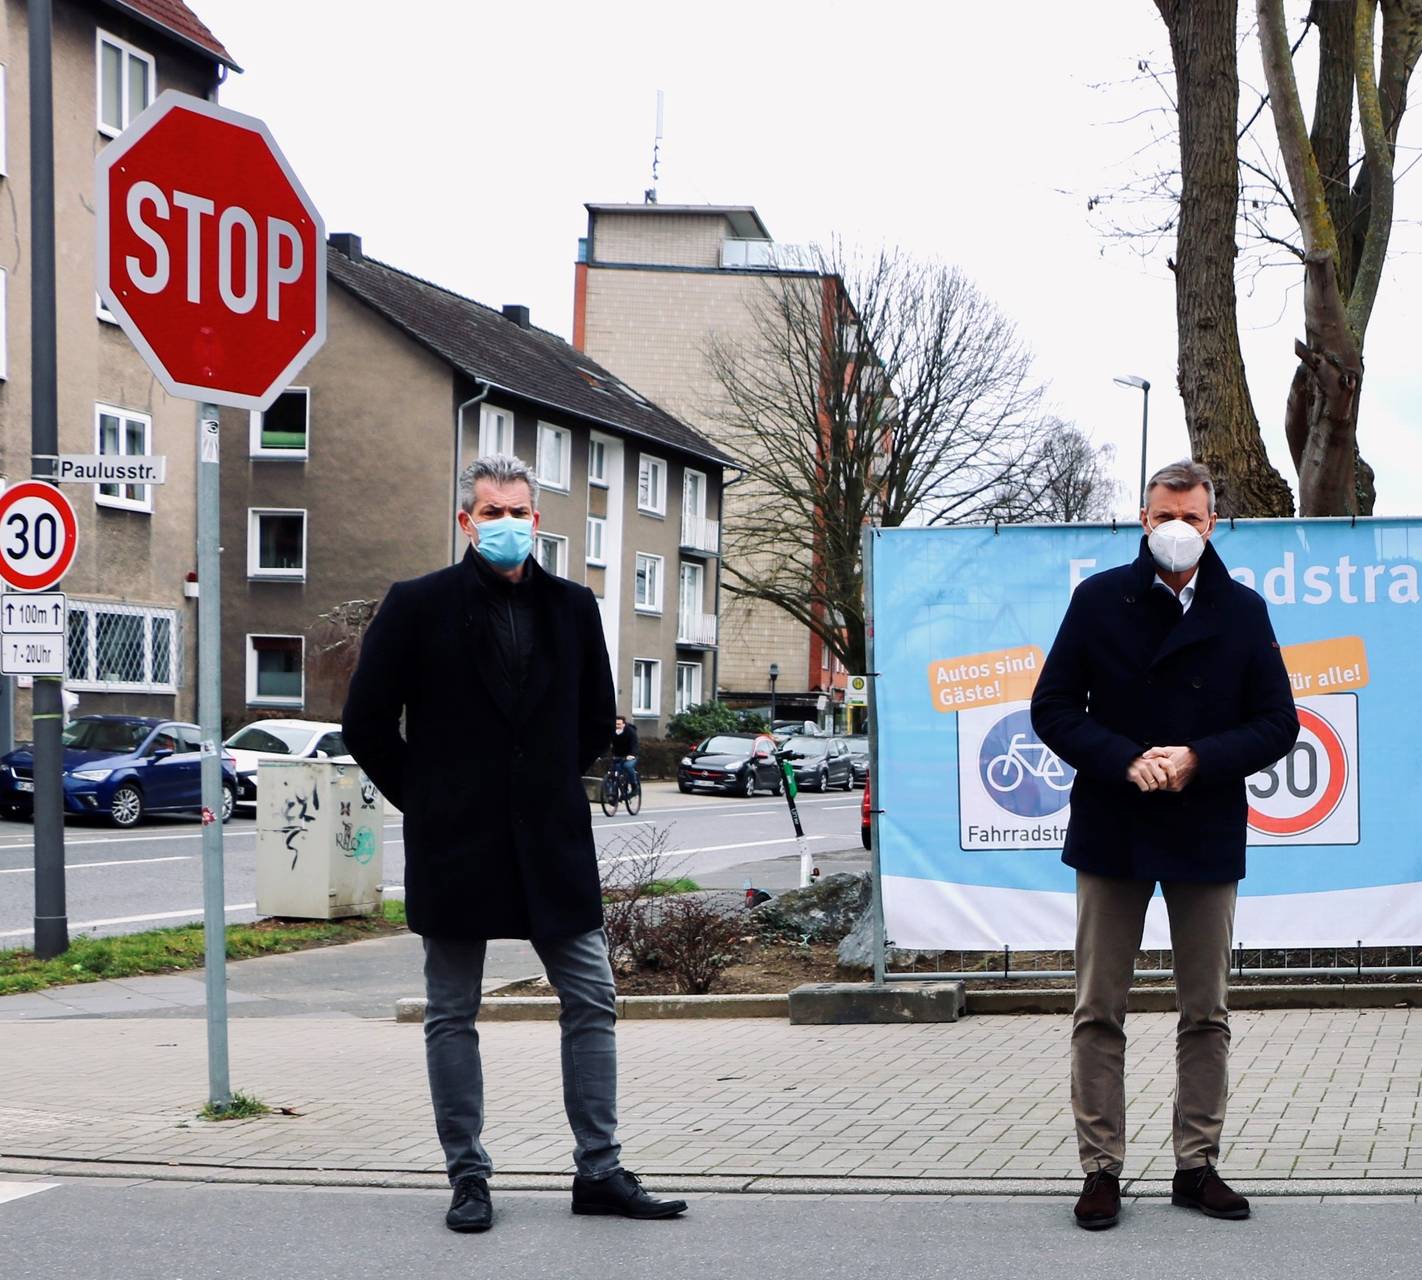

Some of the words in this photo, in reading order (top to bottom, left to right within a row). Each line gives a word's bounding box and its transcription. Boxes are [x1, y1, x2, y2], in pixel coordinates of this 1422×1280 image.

[125, 180, 304, 321] STOP
[61, 461, 157, 480] Paulusstr.
[6, 513, 57, 560] 30
[19, 604, 48, 624] 100m
[12, 644, 19, 663] 7
[936, 663, 991, 684] Autos
[994, 652, 1037, 675] sind
[1318, 663, 1361, 688] alle!
[939, 680, 1002, 705] Gäste!
[1248, 741, 1318, 798] 30
[968, 825, 1068, 843] Fahrradstr
